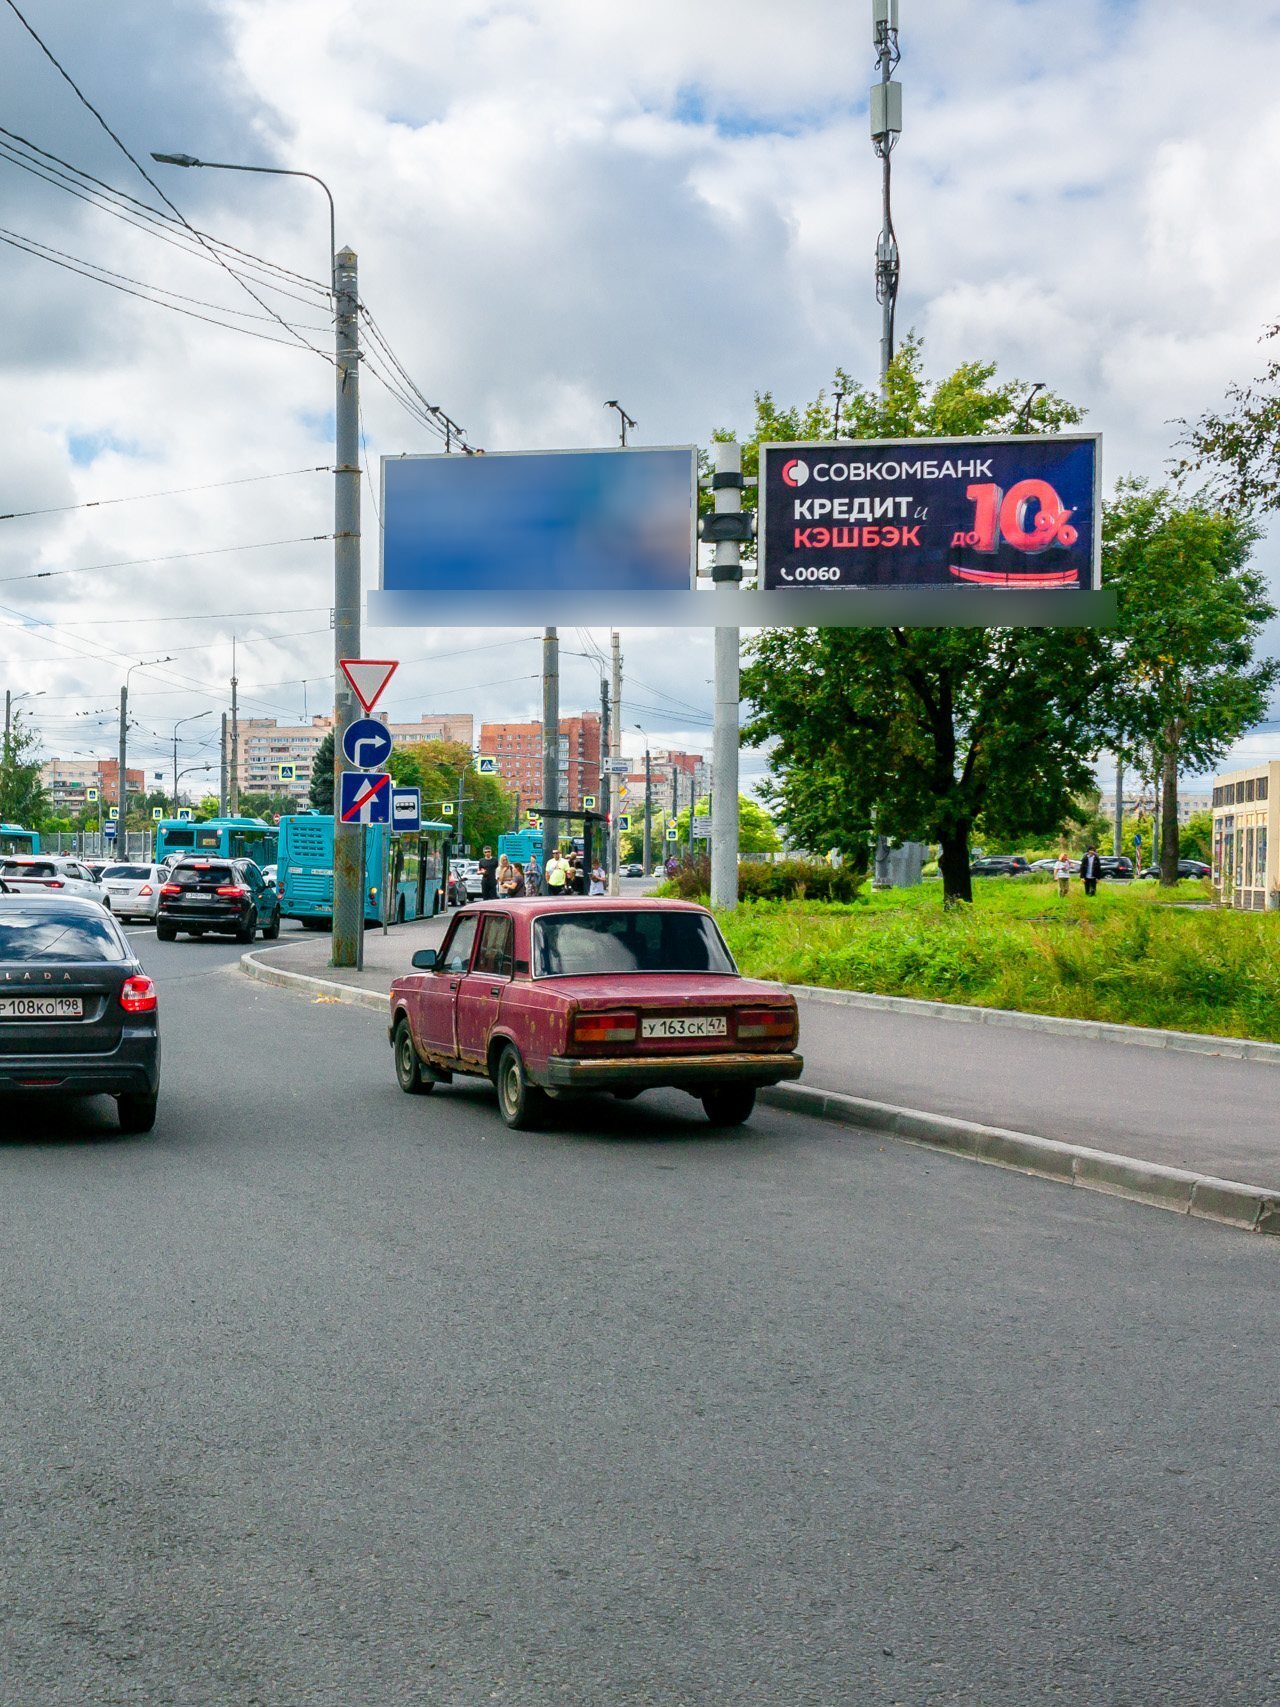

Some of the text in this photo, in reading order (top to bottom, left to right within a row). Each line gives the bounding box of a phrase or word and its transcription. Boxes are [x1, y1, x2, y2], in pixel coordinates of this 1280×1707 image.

[813, 459, 993, 482] СОВКОМБАНК
[794, 496, 928, 522] КРЕДИТ и
[794, 525, 921, 548] КЭШБЭК
[794, 566, 841, 581] 0060
[5, 972, 71, 980] LADA
[58, 999, 79, 1011] 198
[708, 1019, 722, 1029] 47
